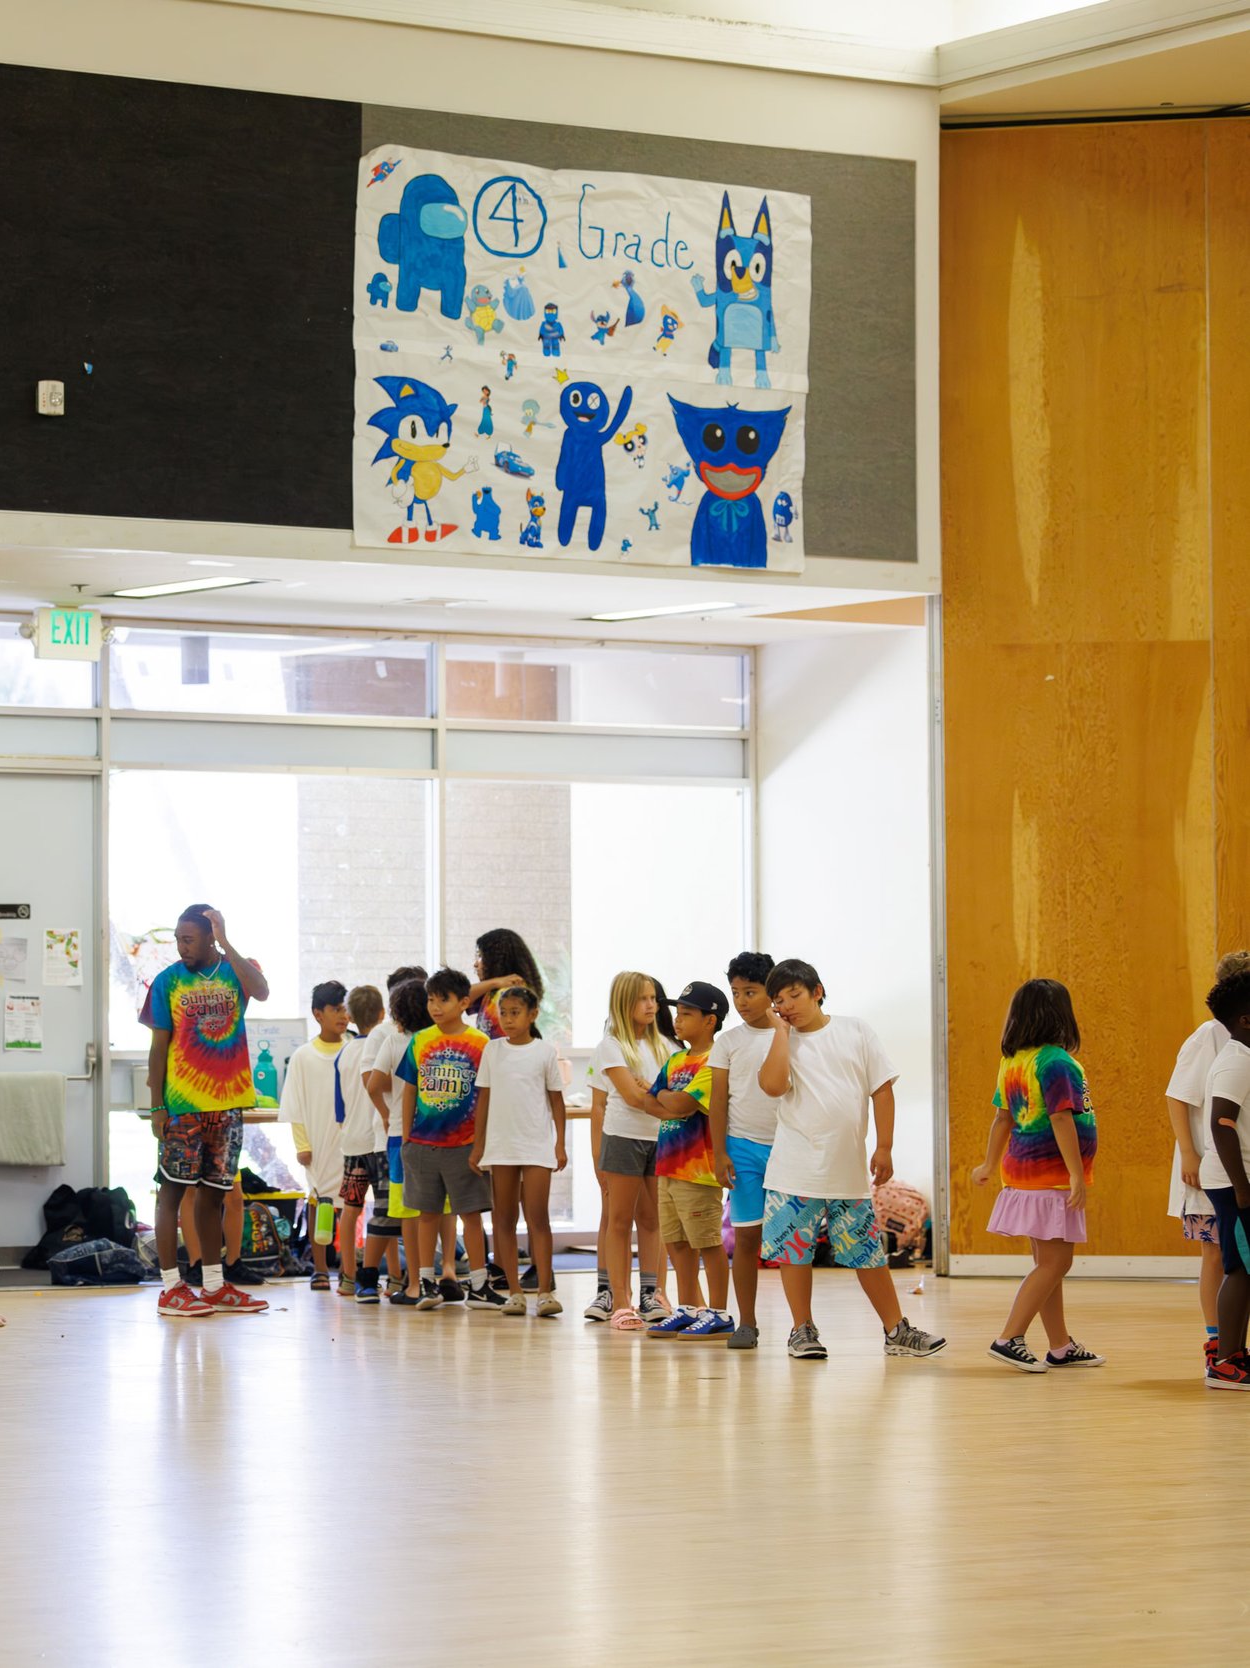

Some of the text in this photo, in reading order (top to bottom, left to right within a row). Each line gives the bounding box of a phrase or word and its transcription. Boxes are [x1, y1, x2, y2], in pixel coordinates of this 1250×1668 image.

[578, 183, 694, 271] Grade
[51, 610, 94, 645] EXIT
[420, 1065, 476, 1079] Summer
